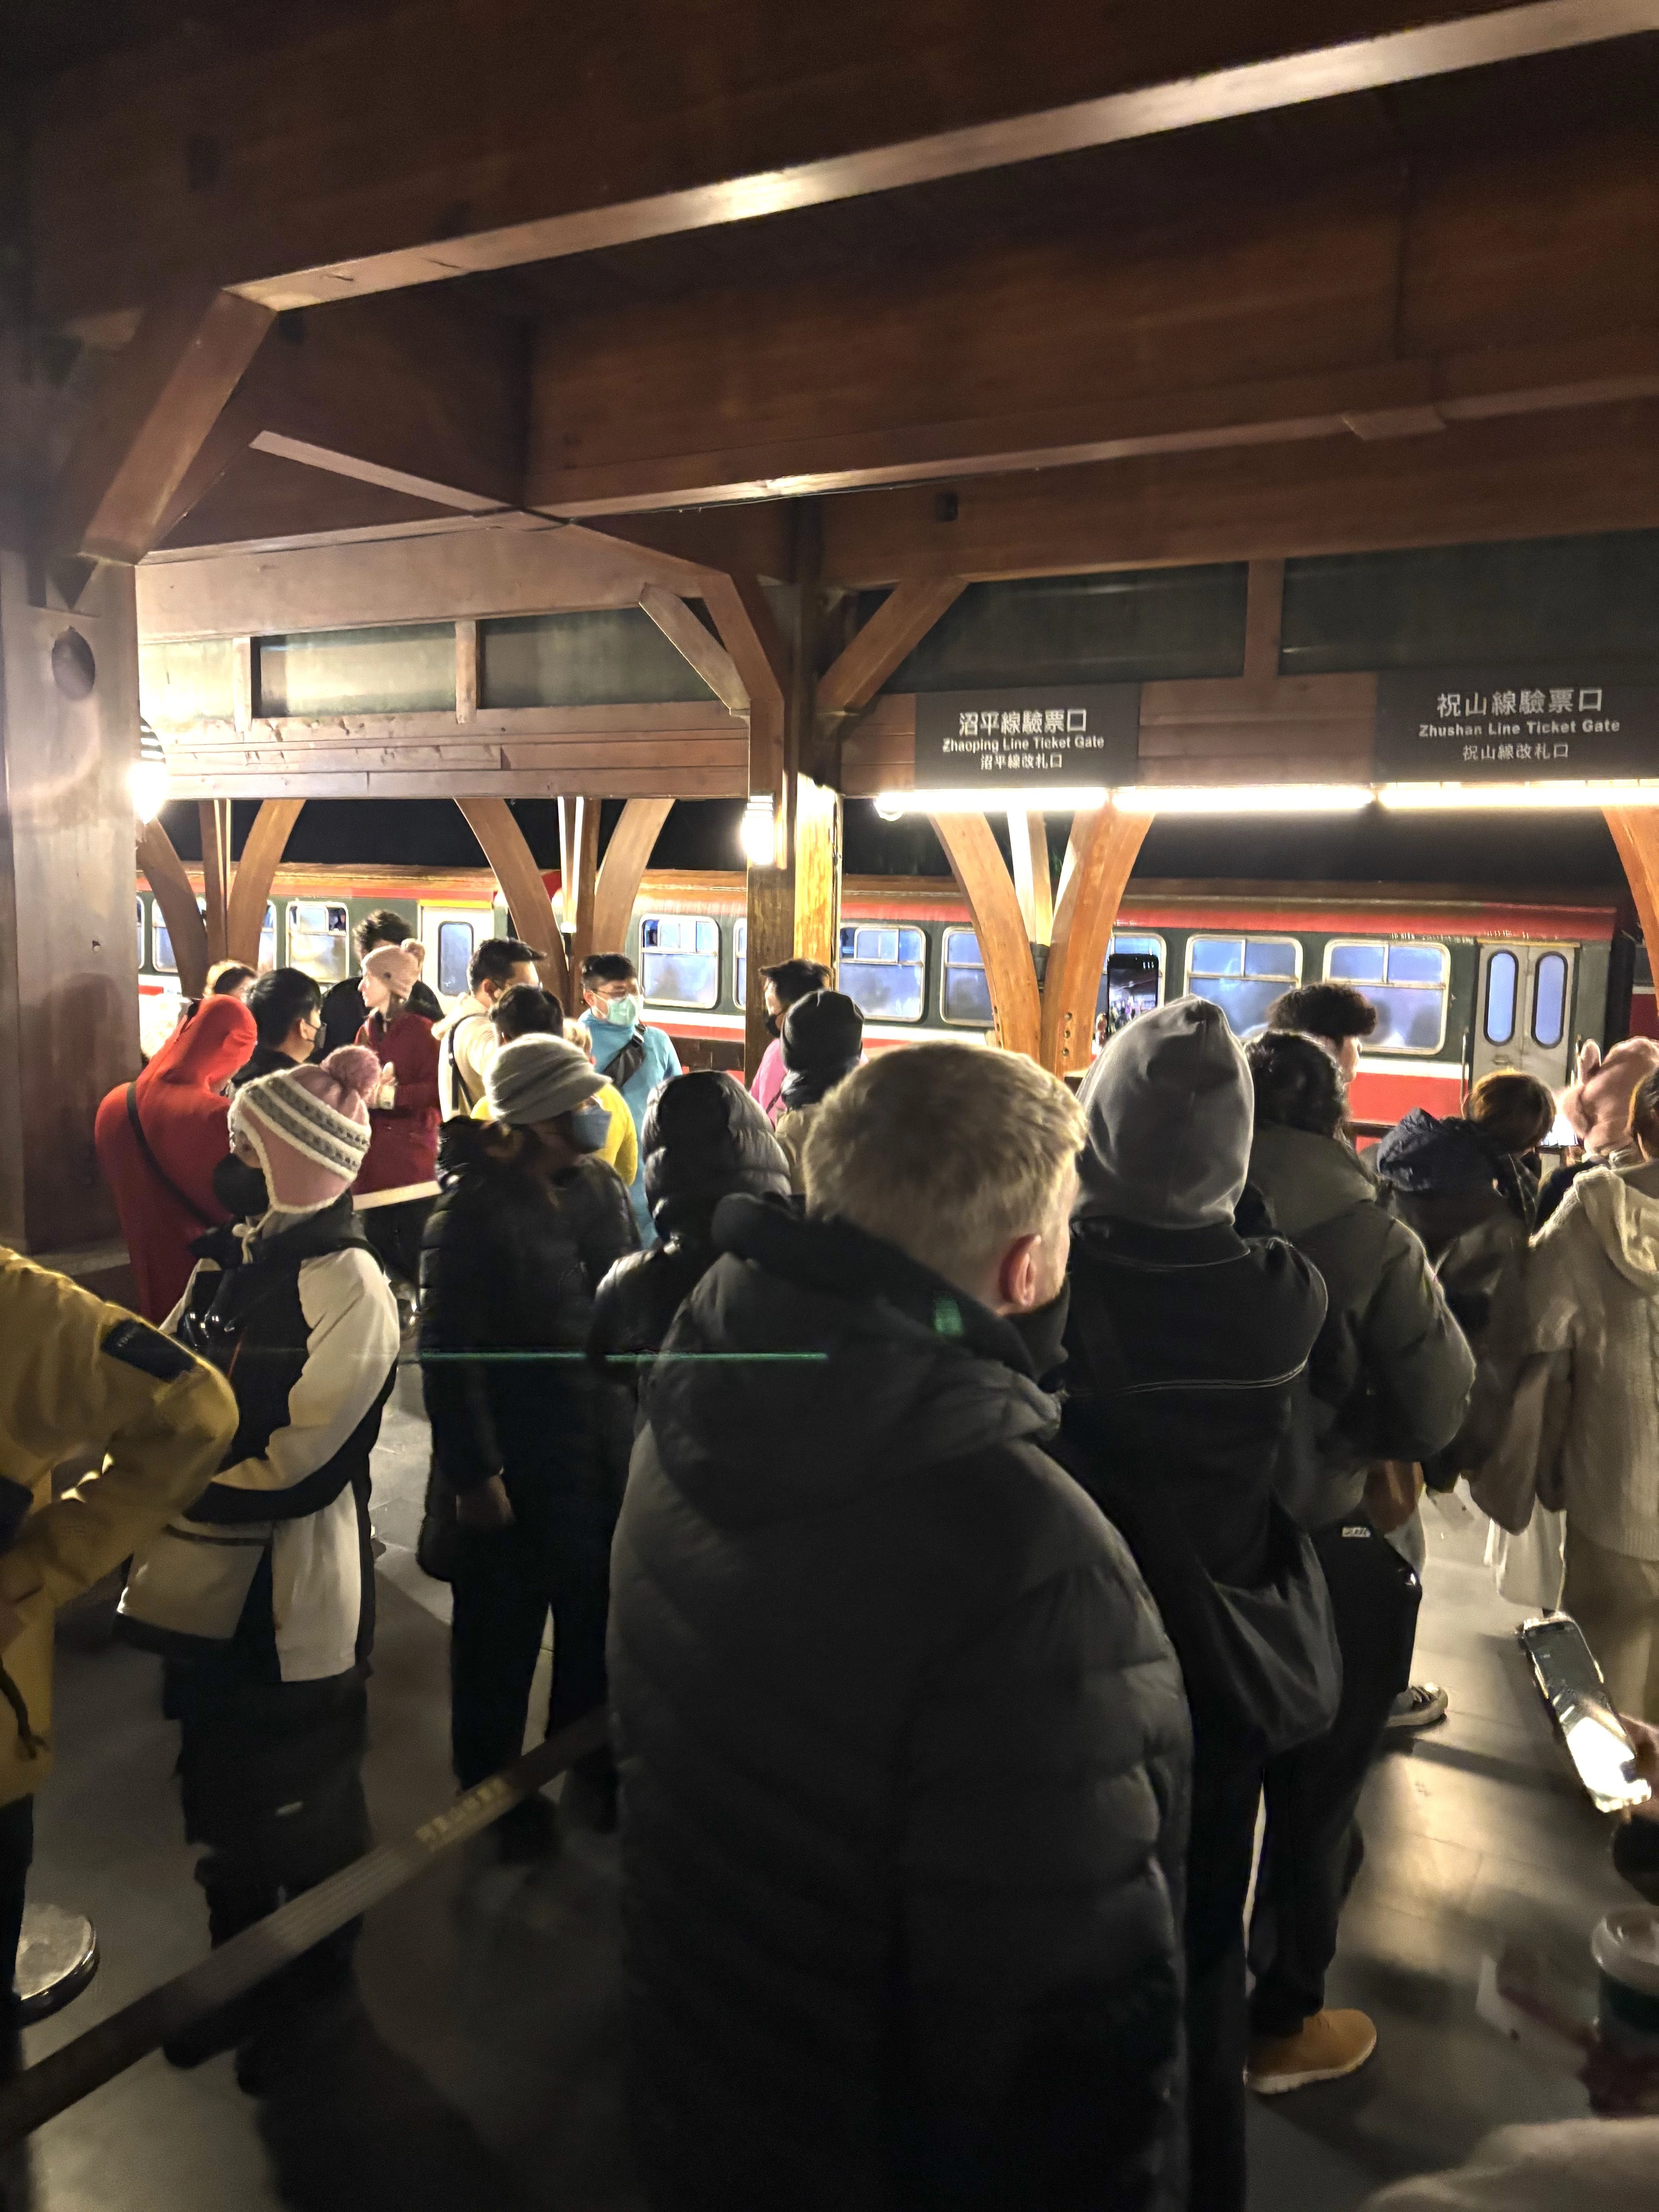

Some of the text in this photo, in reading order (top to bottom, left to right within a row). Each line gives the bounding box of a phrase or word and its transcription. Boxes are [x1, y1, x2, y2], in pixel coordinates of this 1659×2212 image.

[1437, 688, 1602, 718] 祝山線驗票口
[959, 709, 1087, 736] 沼平線驗票口
[1419, 719, 1620, 737] Zhushan Line Ticket Gate
[942, 735, 1104, 753] Zhaoping Line Ticket Gate
[1463, 743, 1569, 761] 祝山線改札口
[980, 753, 1062, 770] 沼平線改札口
